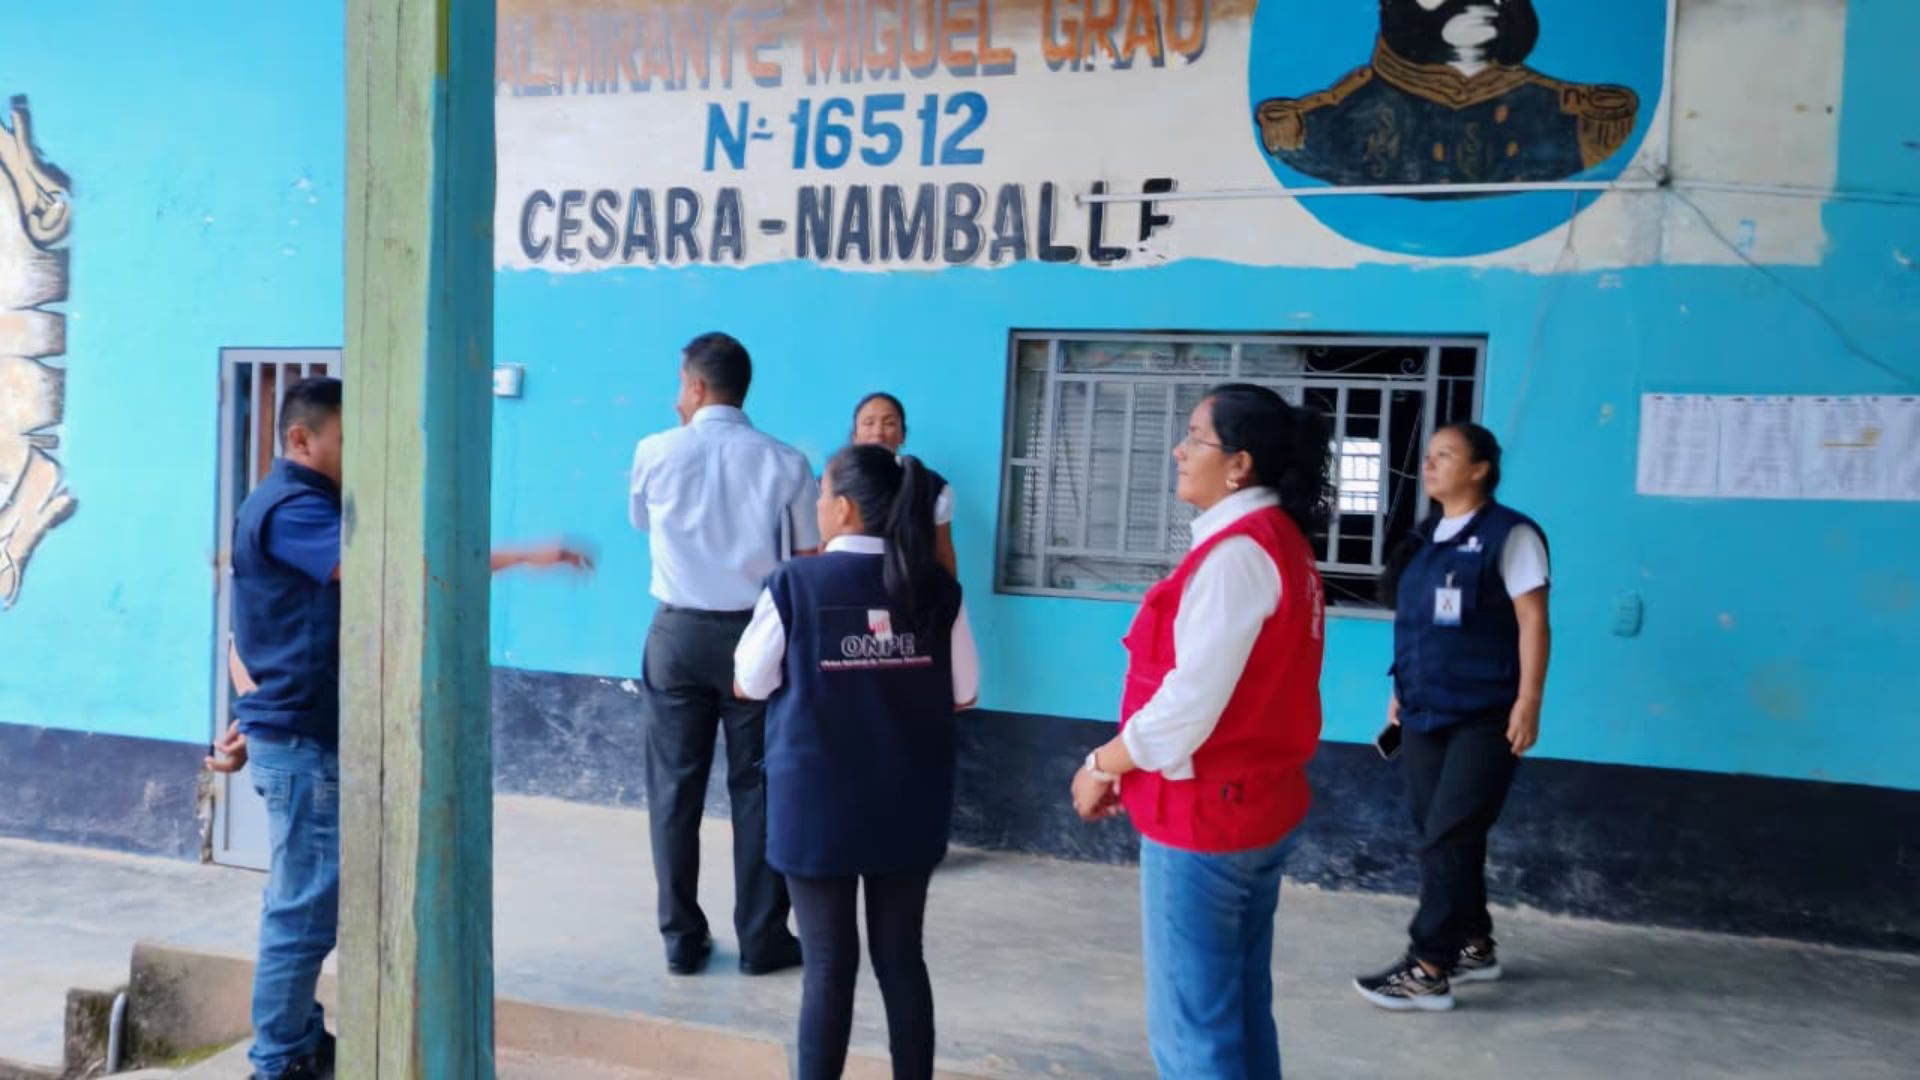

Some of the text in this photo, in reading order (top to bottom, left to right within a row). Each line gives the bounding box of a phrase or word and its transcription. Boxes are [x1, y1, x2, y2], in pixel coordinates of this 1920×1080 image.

[803, 0, 1015, 85] MIGUEL
[789, 92, 988, 171] 16512
[840, 633, 915, 658] ONPE
